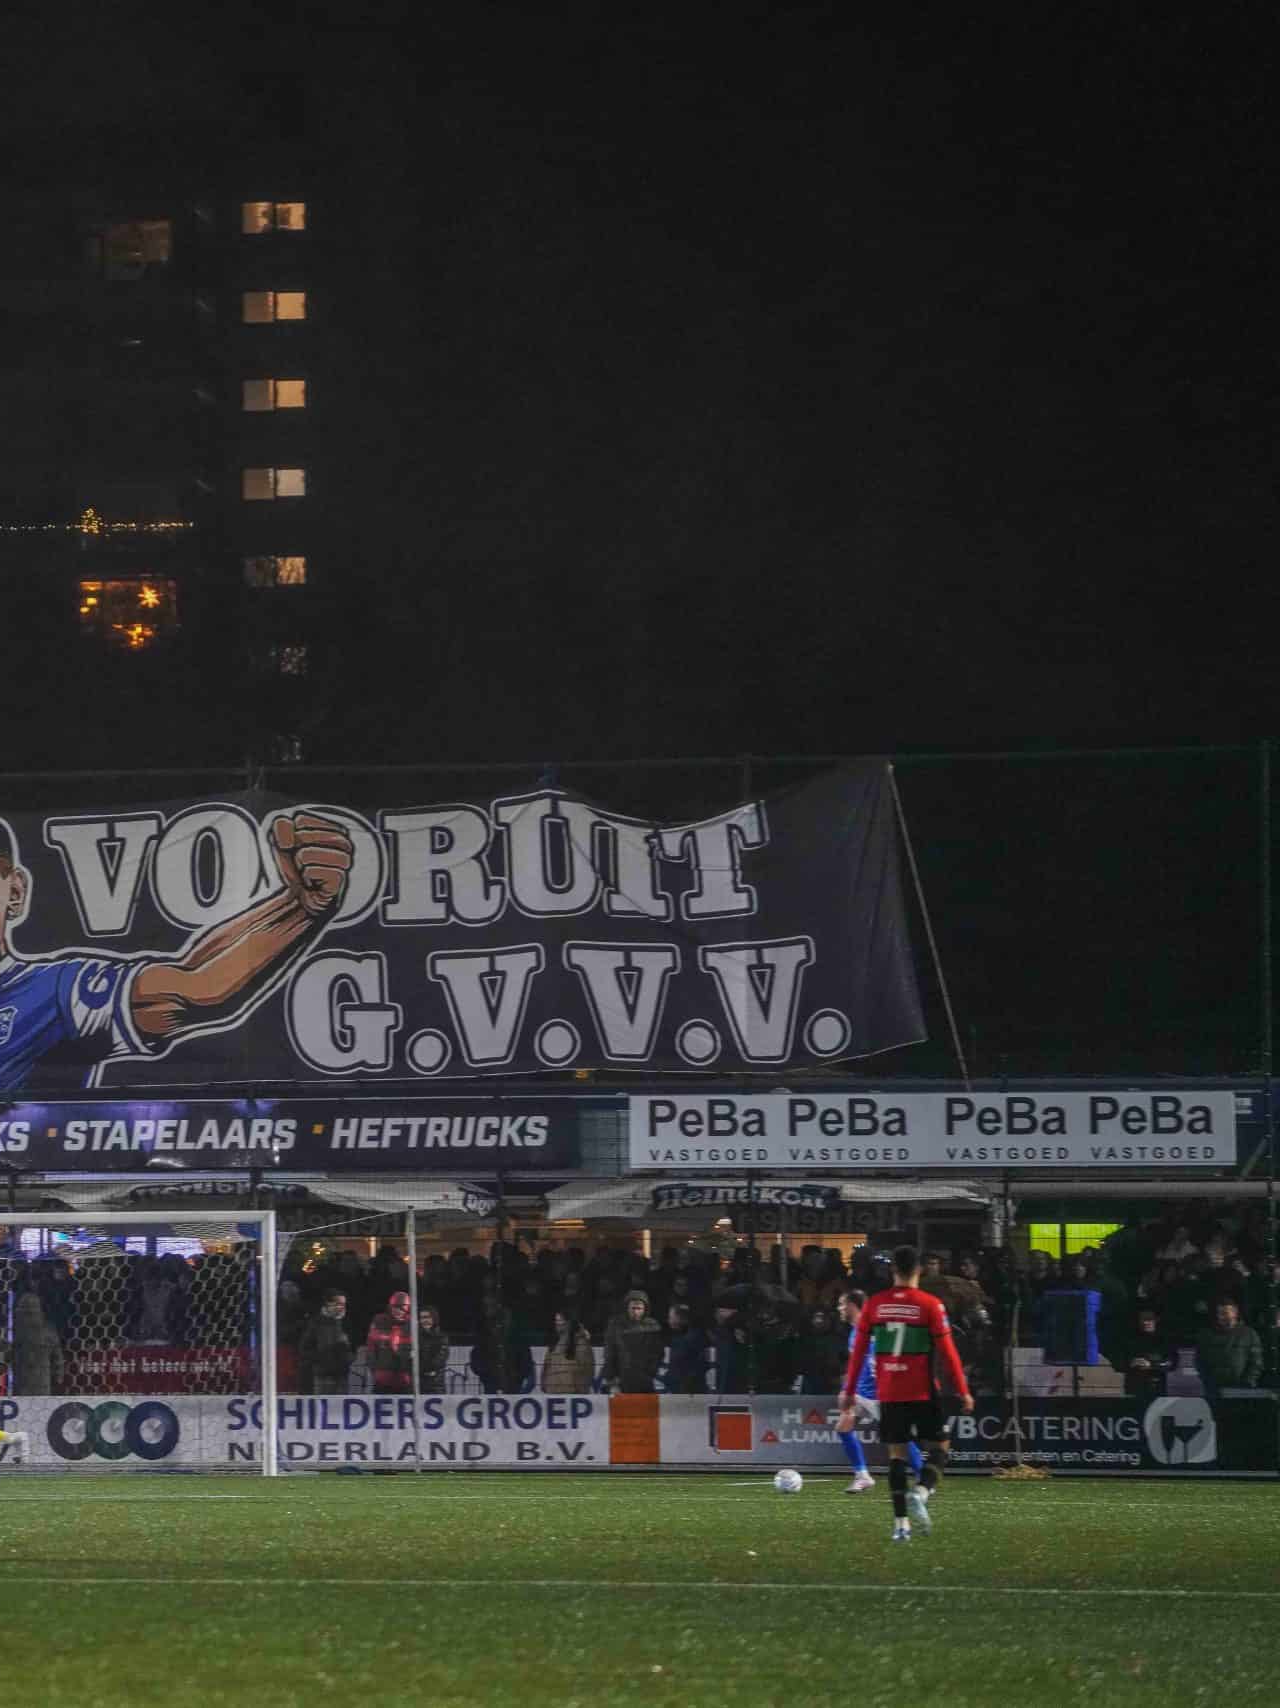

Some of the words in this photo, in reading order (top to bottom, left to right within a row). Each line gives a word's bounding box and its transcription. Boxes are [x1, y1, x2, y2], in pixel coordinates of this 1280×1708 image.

[285, 936, 852, 1075] G.V.V.V.
[648, 1098, 766, 1137] PeBa
[788, 1098, 907, 1137] PeBa
[945, 1096, 1066, 1136] PeBa
[1090, 1095, 1213, 1135] PeBa
[62, 1119, 297, 1152] STAPELAARS
[330, 1115, 549, 1149] HEFTRUCKS
[648, 1149, 768, 1161] VASTGOED
[789, 1148, 909, 1161] VASTGOED
[946, 1147, 1069, 1161] VASTGOED
[1091, 1146, 1215, 1160] VASTGOED
[886, 1322, 907, 1357] 7
[456, 1397, 593, 1430] GROEP
[228, 1441, 491, 1461] NDERLAND
[516, 1441, 595, 1461] B.V.
[1084, 1448, 1141, 1465] Catering
